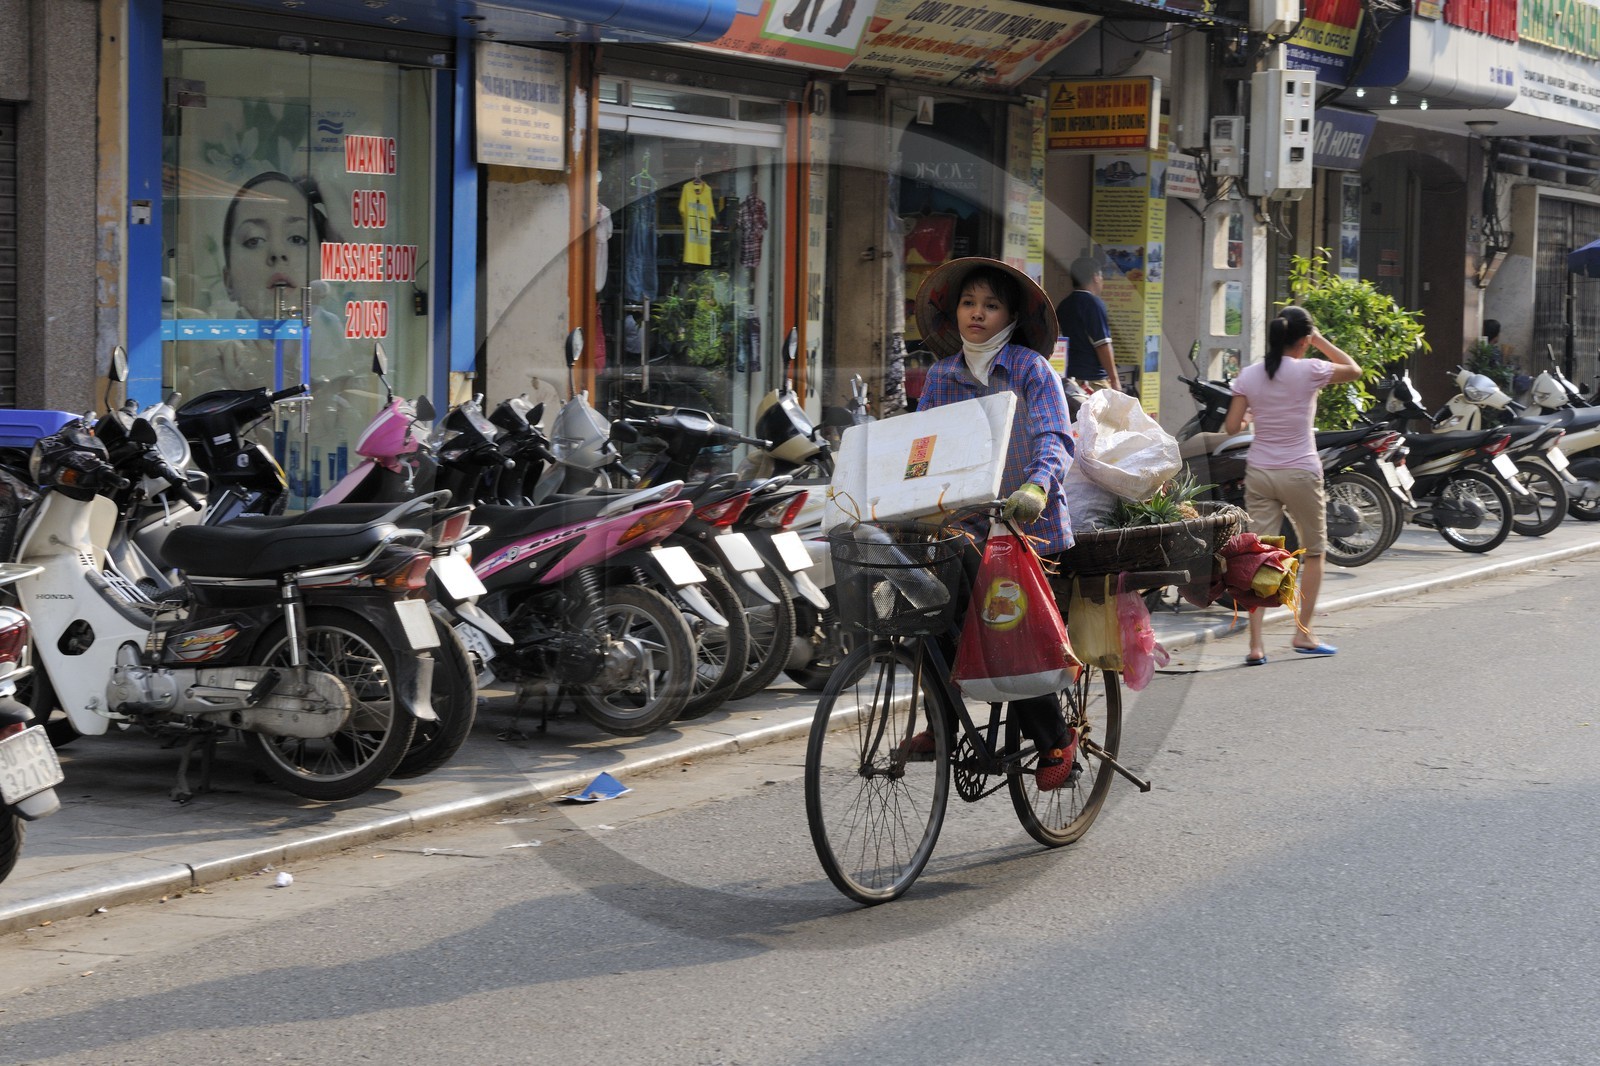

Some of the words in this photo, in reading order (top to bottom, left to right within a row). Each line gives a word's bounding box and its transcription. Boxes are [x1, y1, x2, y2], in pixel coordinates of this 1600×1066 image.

[1324, 31, 1351, 51] OFFICE
[1050, 116, 1067, 132] TOUR
[1068, 115, 1111, 131] INFORMATION
[1117, 113, 1146, 130] BOOKING
[345, 134, 397, 176] WAXING
[1326, 130, 1365, 160] HOTEL
[352, 189, 361, 229] 6
[361, 190, 388, 229] USD
[320, 242, 384, 282] MASSAGE
[384, 244, 418, 282] BODY
[344, 300, 362, 339] 20
[363, 300, 389, 339] USD
